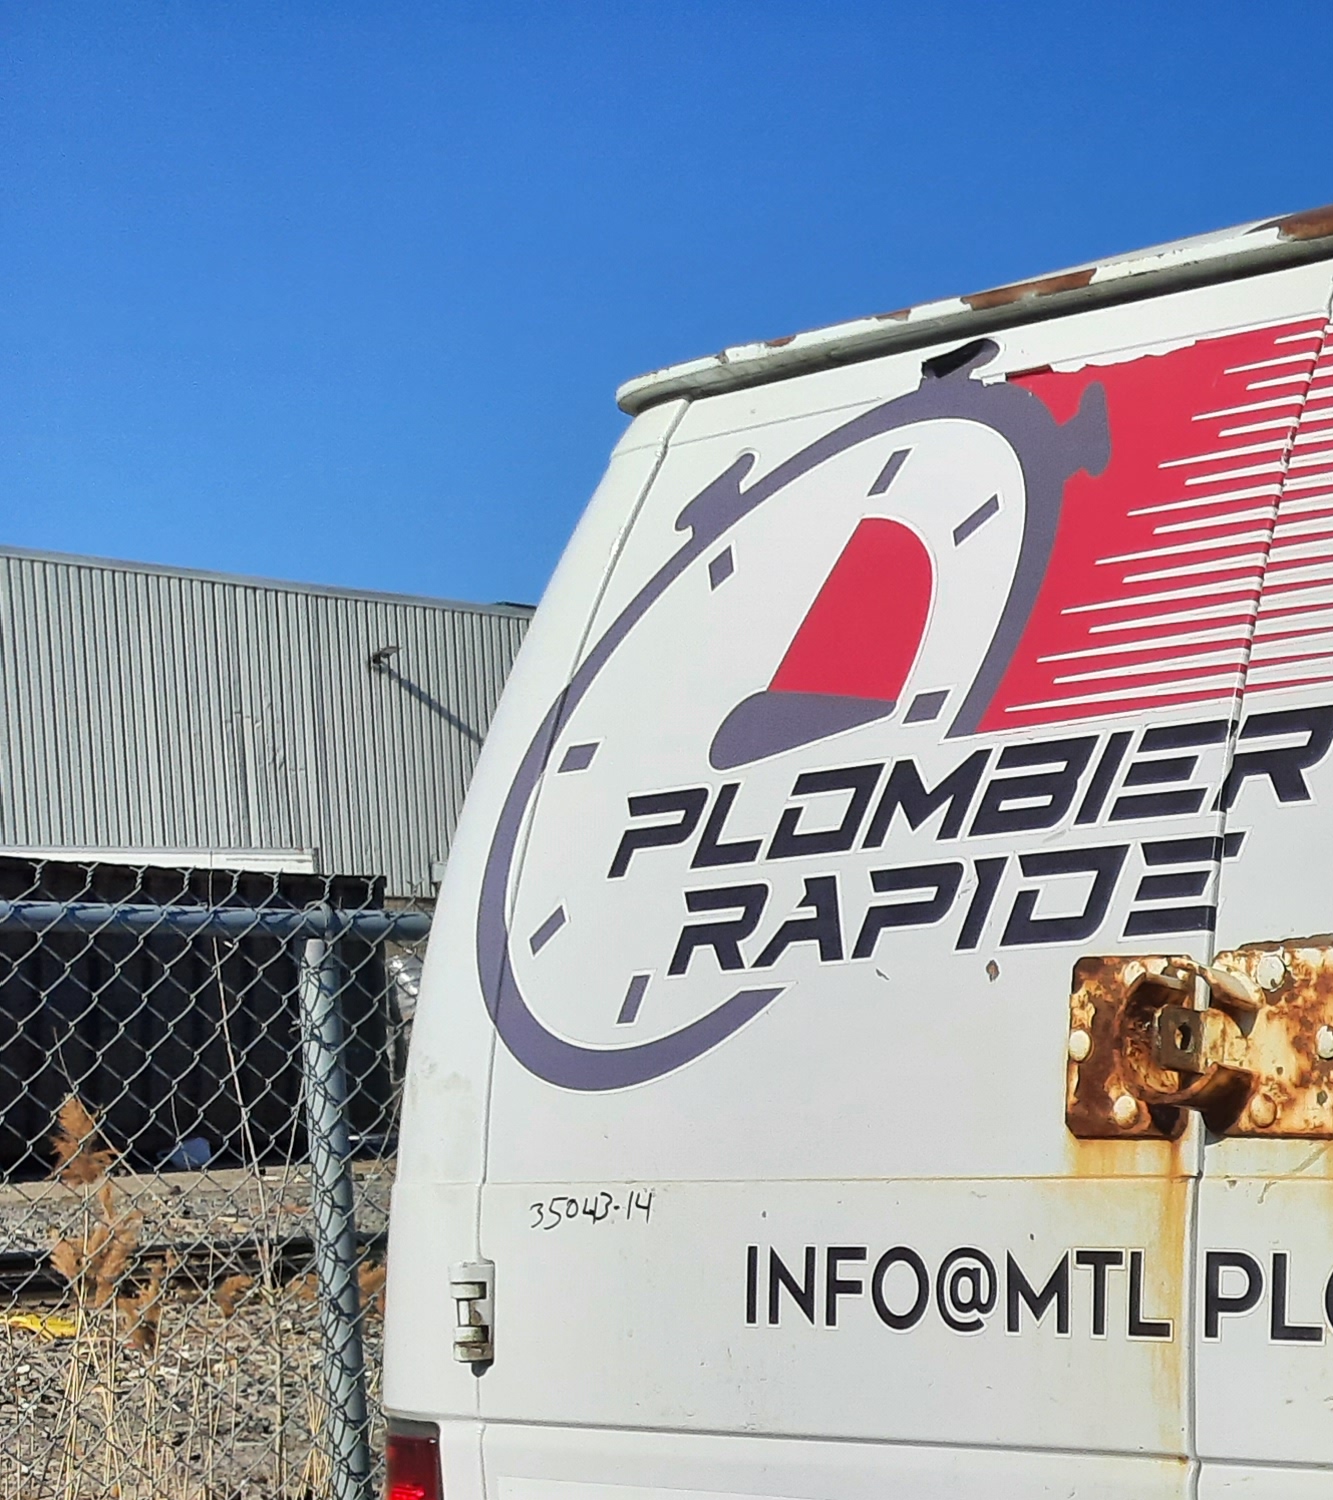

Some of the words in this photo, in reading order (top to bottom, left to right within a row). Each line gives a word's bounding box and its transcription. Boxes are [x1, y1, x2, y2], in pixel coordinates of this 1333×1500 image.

[669, 834, 1242, 975] RAPIDE
[530, 1191, 652, 1230] 35043-14
[746, 1245, 1171, 1338] INFO@MTL
